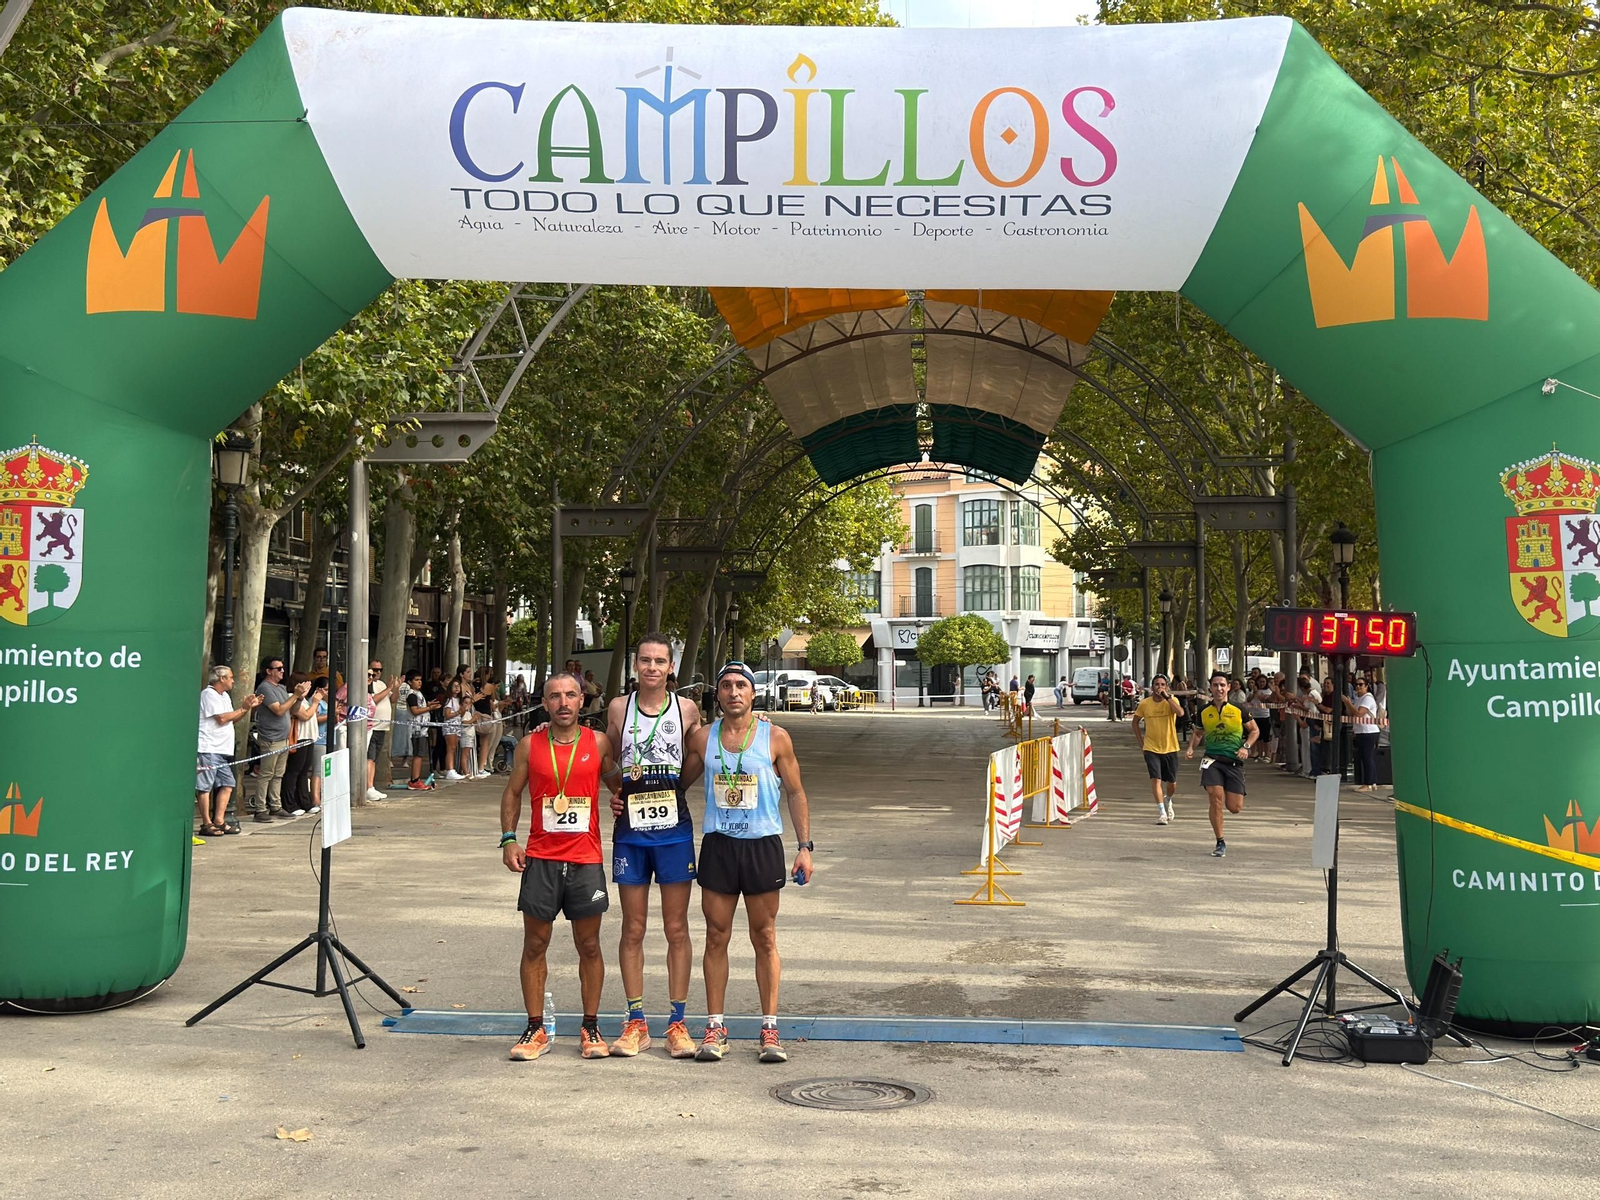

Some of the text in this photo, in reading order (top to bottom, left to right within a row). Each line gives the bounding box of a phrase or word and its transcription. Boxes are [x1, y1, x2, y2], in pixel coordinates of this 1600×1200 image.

[449, 62, 1118, 189] CAMPILLOS
[450, 188, 1112, 218] TODO LO QUE NECESITAS
[458, 214, 504, 234] Agua
[532, 216, 624, 235] Naturaleza
[652, 219, 689, 236] Aire
[712, 220, 761, 236] Motor
[790, 221, 883, 237] Patrimonio
[912, 221, 974, 241] Deporte
[1003, 221, 1110, 236] Gastronomia
[0, 643, 142, 668] miento de
[1447, 655, 1600, 687] Ayuntamie
[0, 680, 78, 707] pillos
[557, 811, 578, 824] 28
[638, 805, 668, 820] 139
[25, 853, 77, 872] DEL
[86, 850, 134, 871] REY
[1452, 868, 1585, 892] CAMINITO
